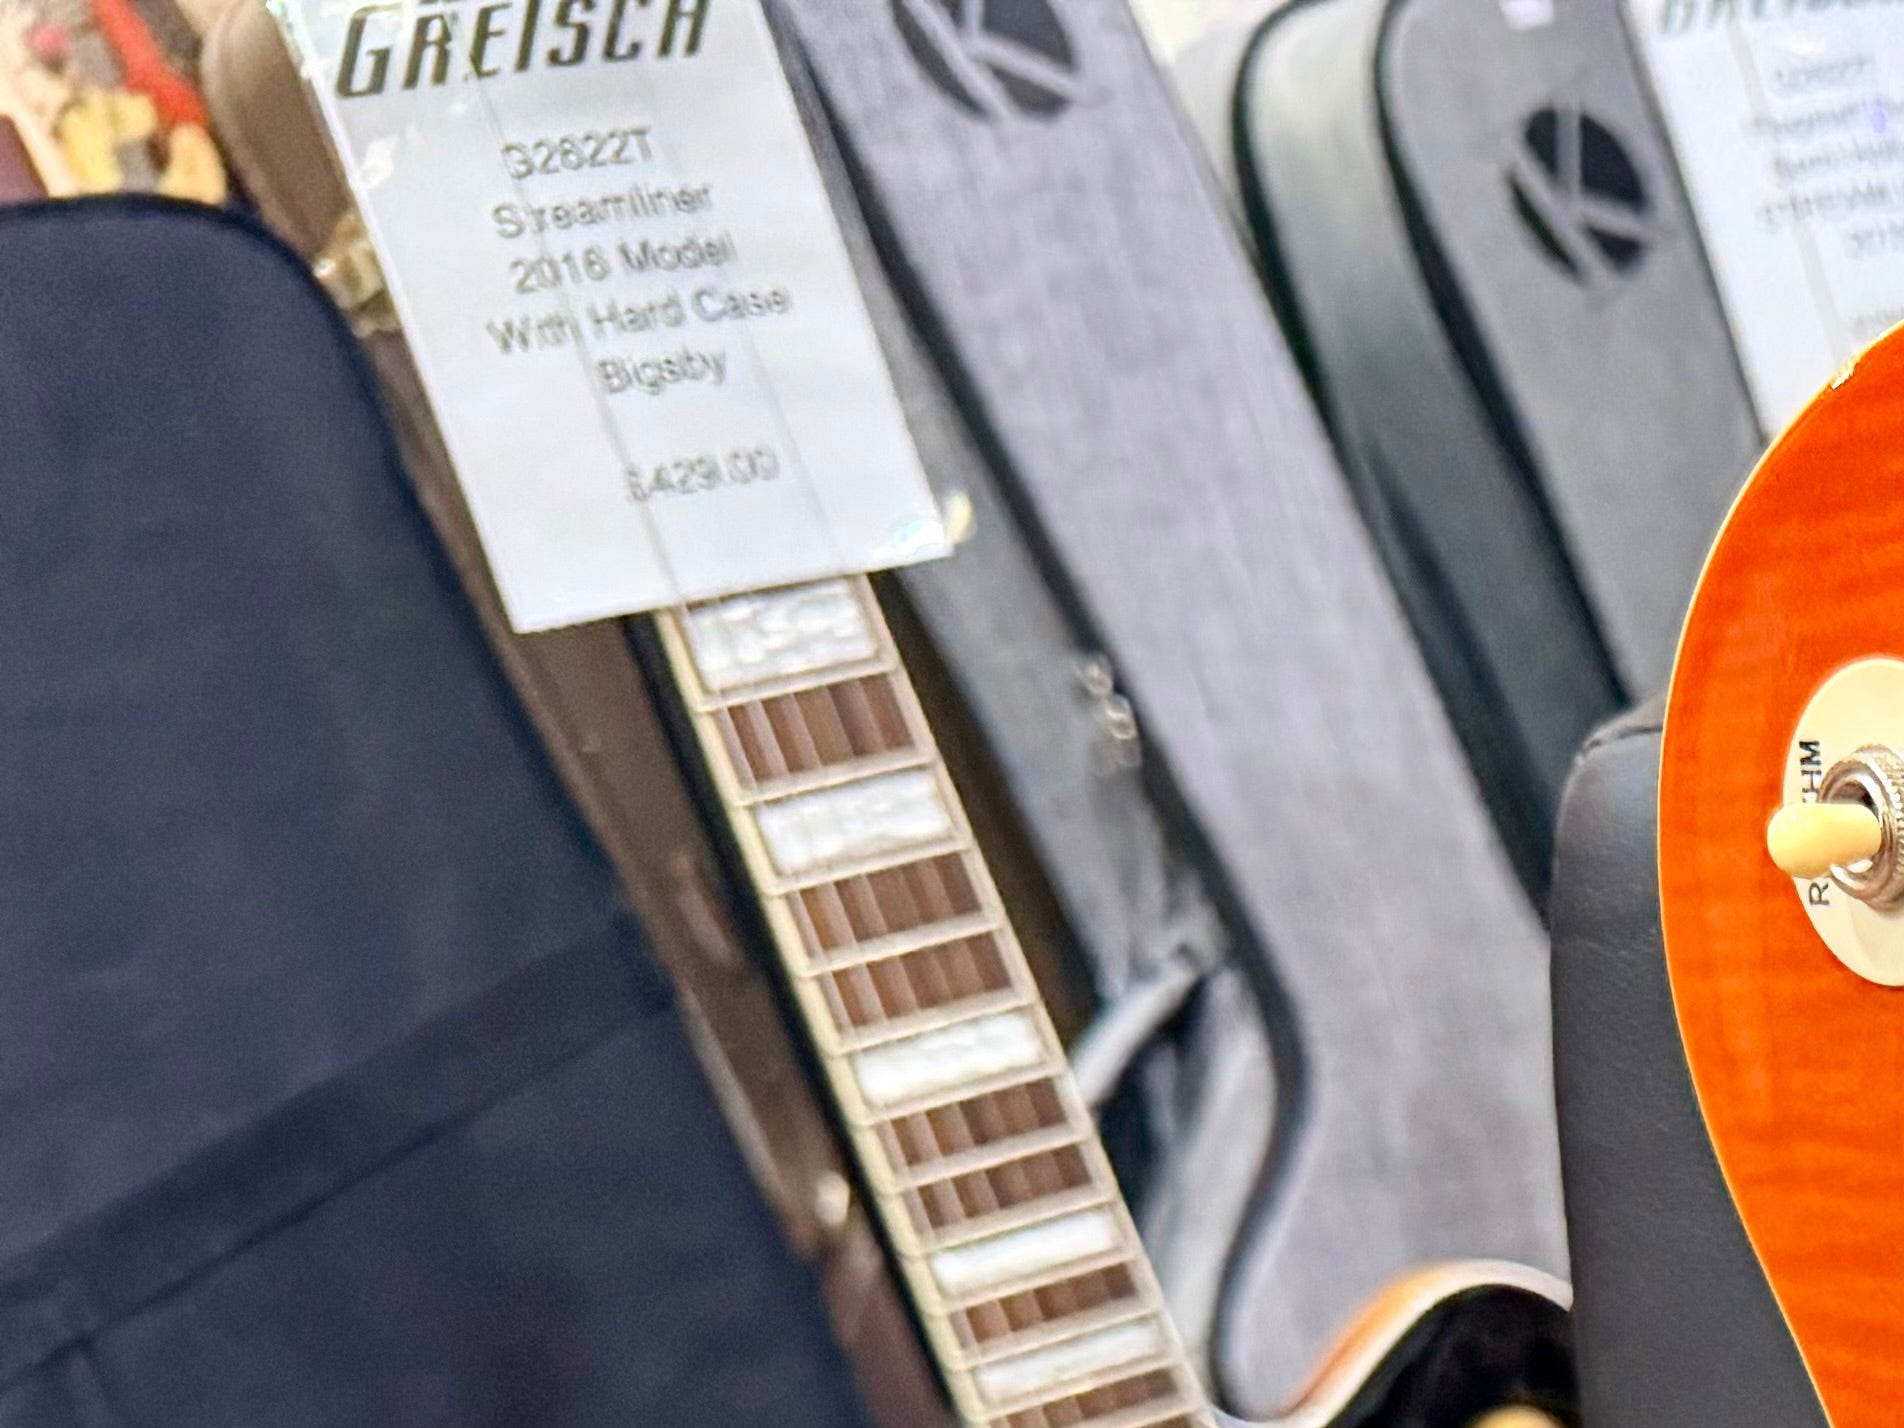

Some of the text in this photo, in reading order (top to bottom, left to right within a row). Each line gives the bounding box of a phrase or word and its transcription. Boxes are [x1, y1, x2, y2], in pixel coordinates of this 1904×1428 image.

[492, 184, 712, 239] Streamliner
[510, 231, 738, 294] 2016 Model
[485, 284, 792, 353] With Hard Case
[597, 347, 728, 395] Bigsby
